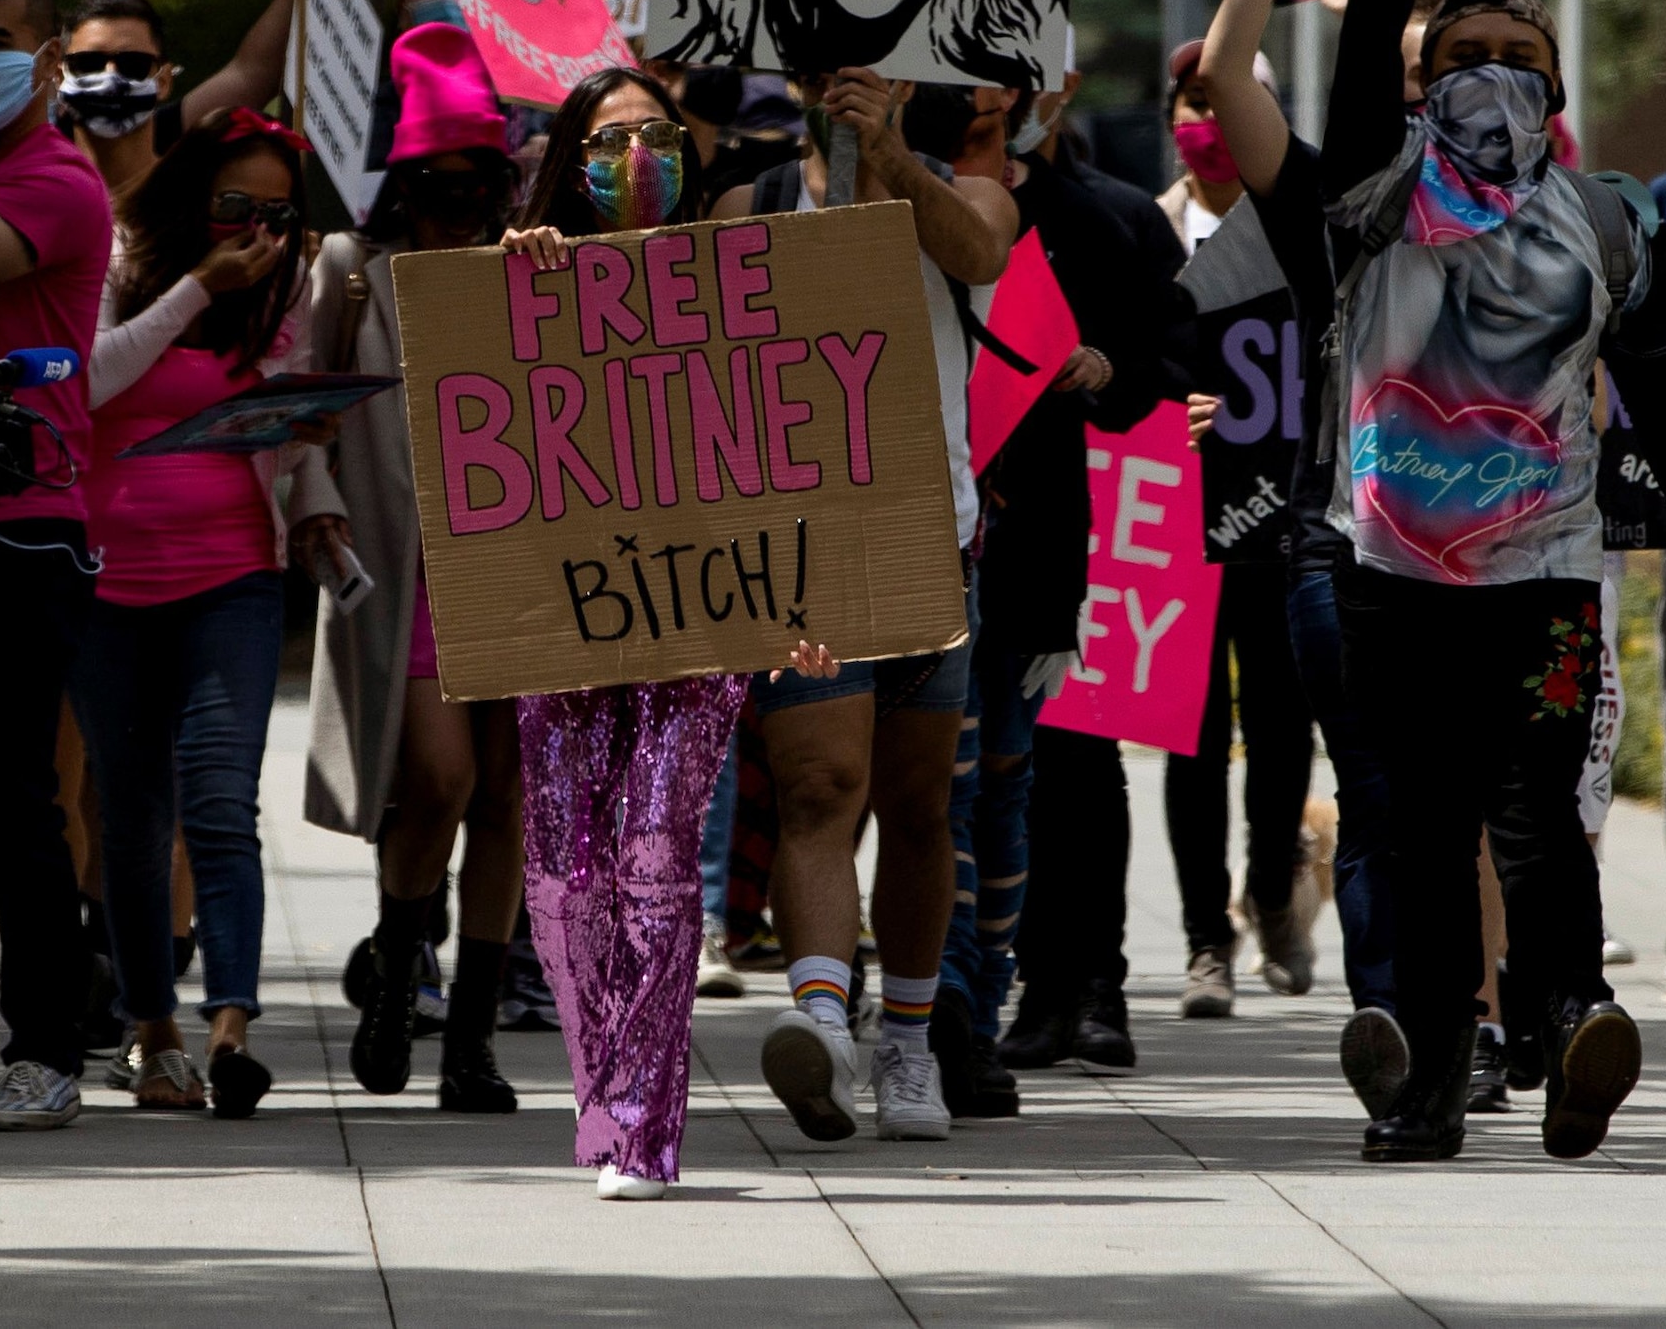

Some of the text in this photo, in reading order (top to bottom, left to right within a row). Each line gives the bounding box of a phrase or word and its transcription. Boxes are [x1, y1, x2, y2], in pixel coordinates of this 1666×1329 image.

[504, 222, 779, 362] FREE
[436, 330, 887, 537] BRITNEY
[1206, 474, 1288, 549] what
